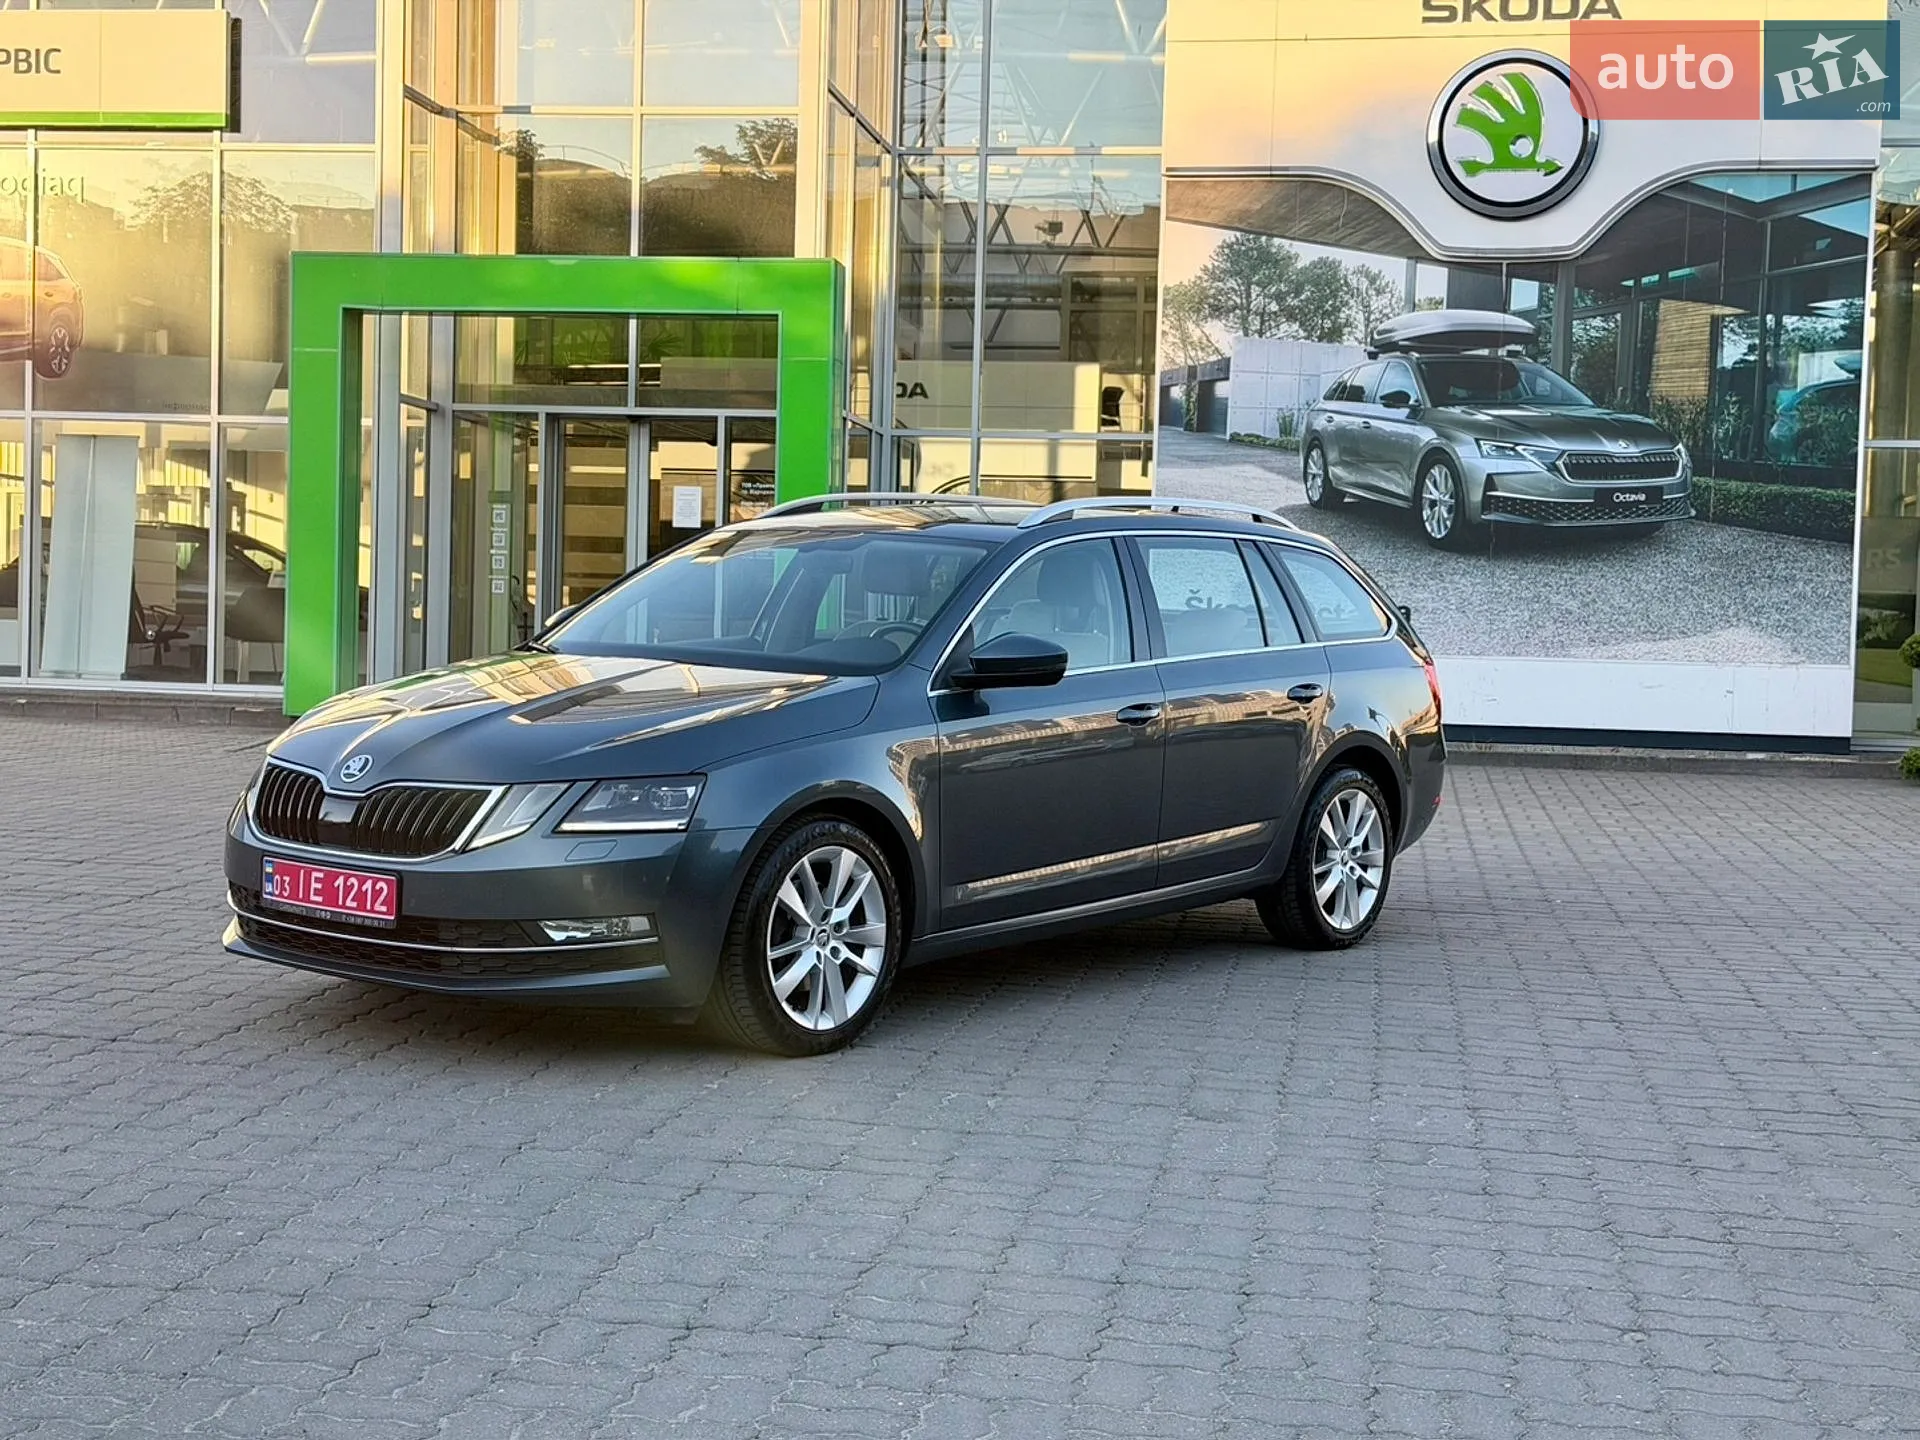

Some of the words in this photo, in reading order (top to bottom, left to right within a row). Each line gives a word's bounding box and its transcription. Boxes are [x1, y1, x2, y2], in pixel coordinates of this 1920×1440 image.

[1613, 491, 1646, 503] Octavia
[273, 874, 291, 897] 03
[333, 875, 388, 912] 1212
